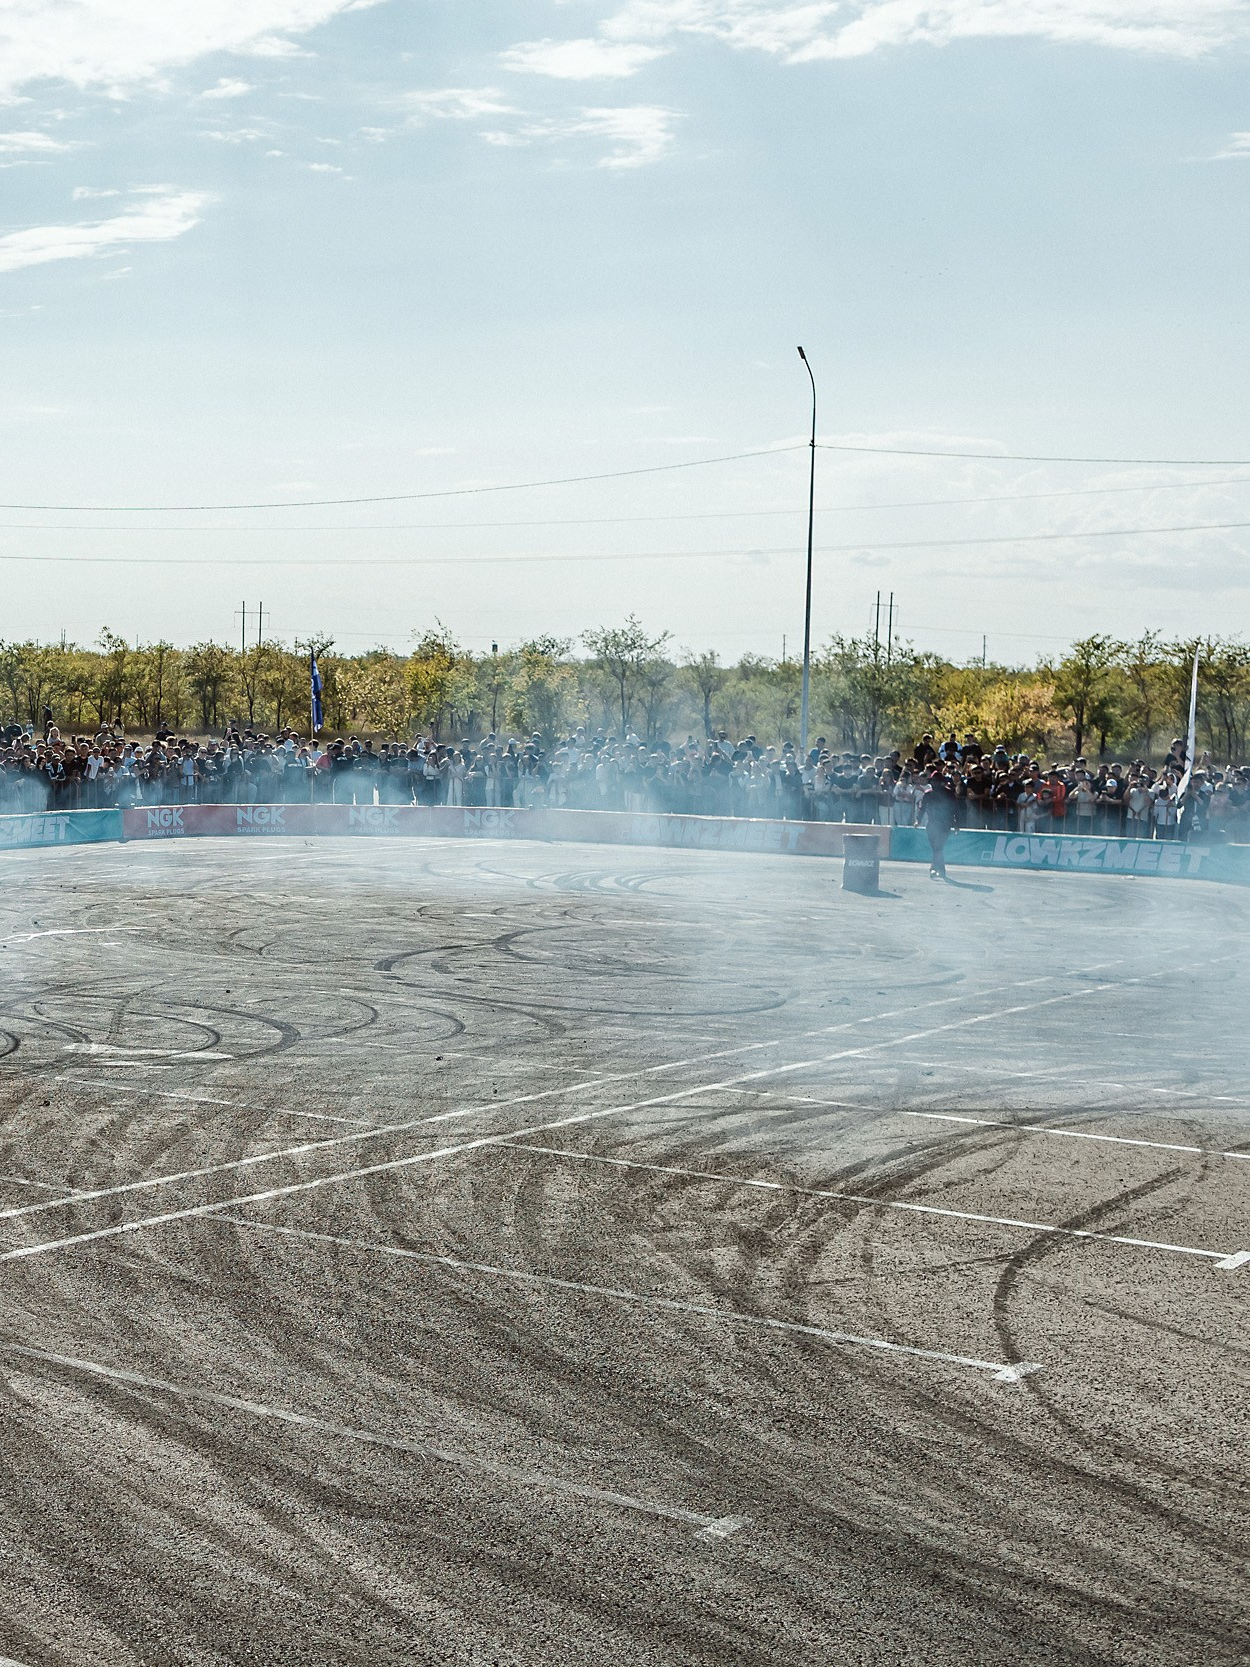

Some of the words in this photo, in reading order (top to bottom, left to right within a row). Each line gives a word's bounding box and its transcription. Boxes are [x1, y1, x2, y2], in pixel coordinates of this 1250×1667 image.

[147, 806, 184, 828] NGK
[236, 806, 286, 825] NGK
[349, 806, 400, 826] NGK
[463, 809, 516, 829] NGK
